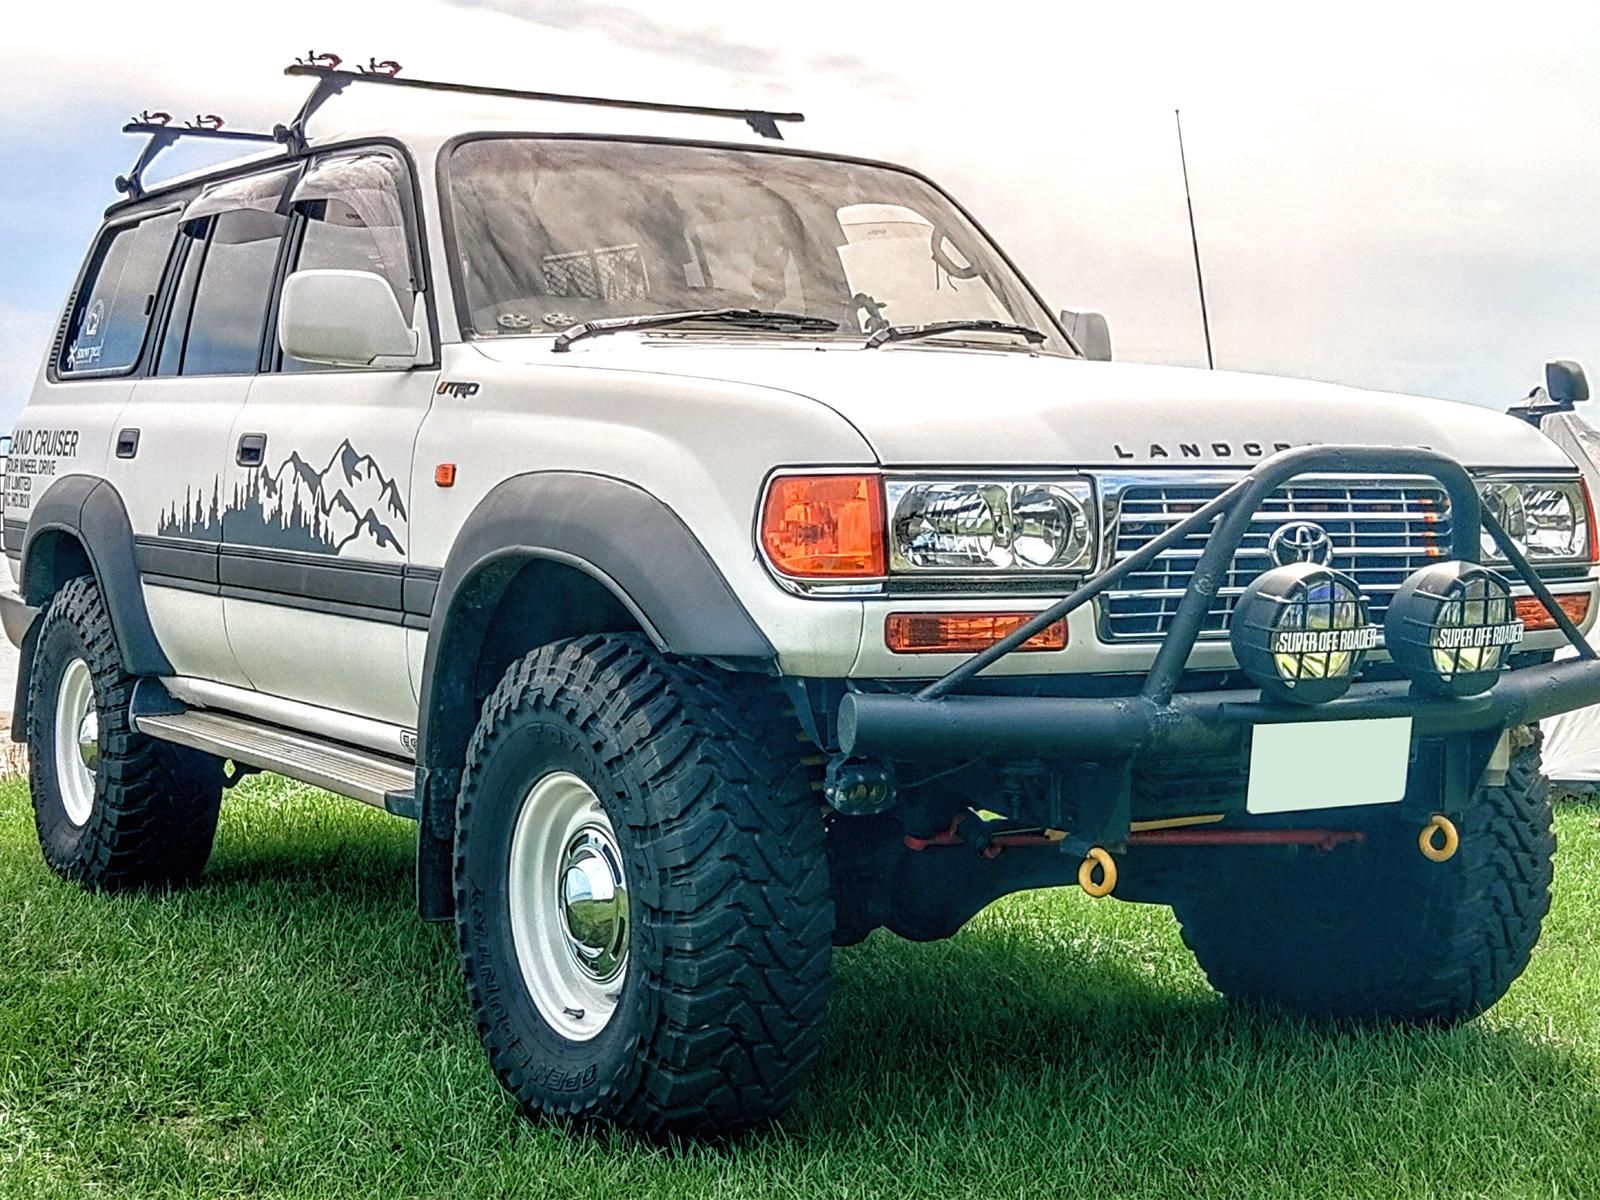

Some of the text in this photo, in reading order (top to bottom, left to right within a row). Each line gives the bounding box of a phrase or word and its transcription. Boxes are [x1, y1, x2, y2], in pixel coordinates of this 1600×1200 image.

[33, 430, 79, 457] CRUISER
[20, 459, 37, 474] WHEEL
[39, 460, 56, 476] DRIVE
[12, 476, 31, 491] LIMITED
[1280, 628, 1377, 653] SUPER OFF ROADER
[1440, 623, 1524, 648] SUPER OFF ROADER
[529, 1063, 598, 1093] OPEN
